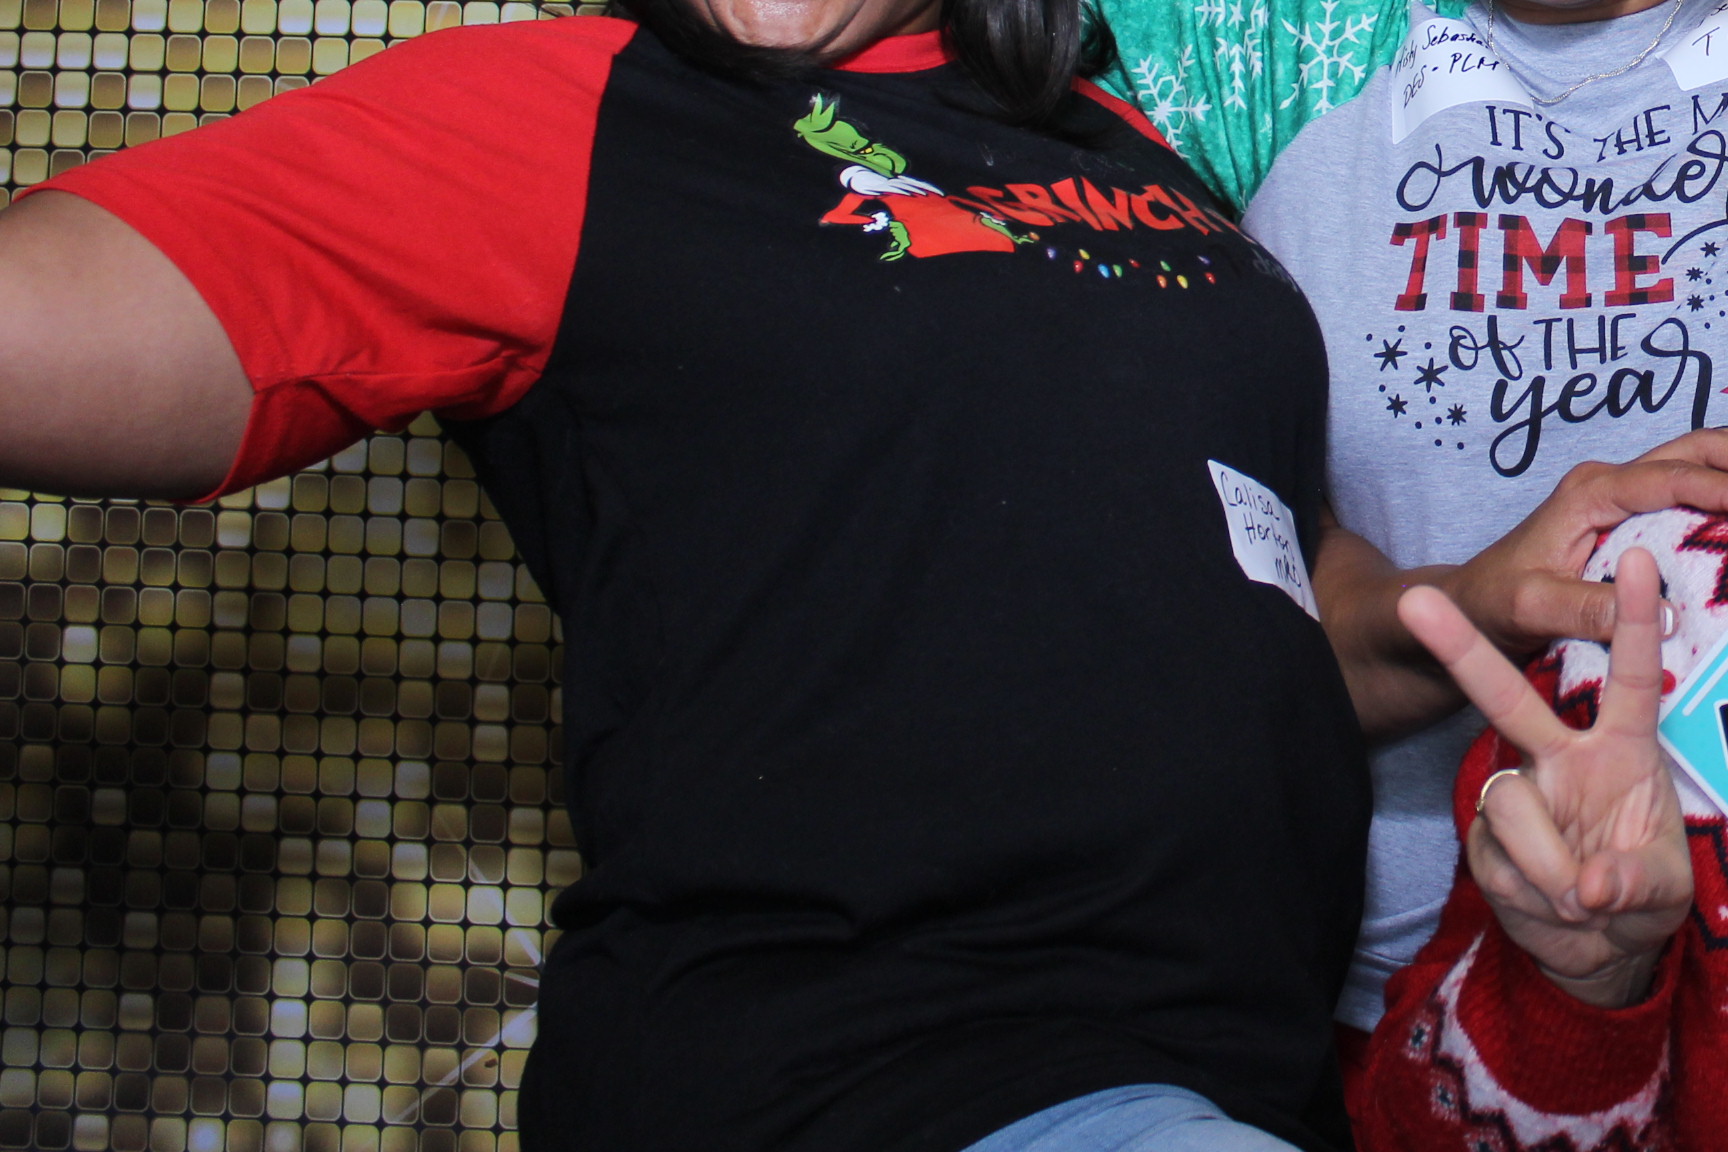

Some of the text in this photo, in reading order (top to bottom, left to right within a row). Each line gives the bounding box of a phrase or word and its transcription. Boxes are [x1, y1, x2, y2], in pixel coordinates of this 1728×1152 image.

[1691, 26, 1721, 56] T
[1485, 104, 1571, 160] IT'S
[1593, 104, 1672, 163] THE
[1389, 211, 1676, 313] TIME
[1447, 312, 1638, 380] of THE
[1488, 316, 1713, 478] year
